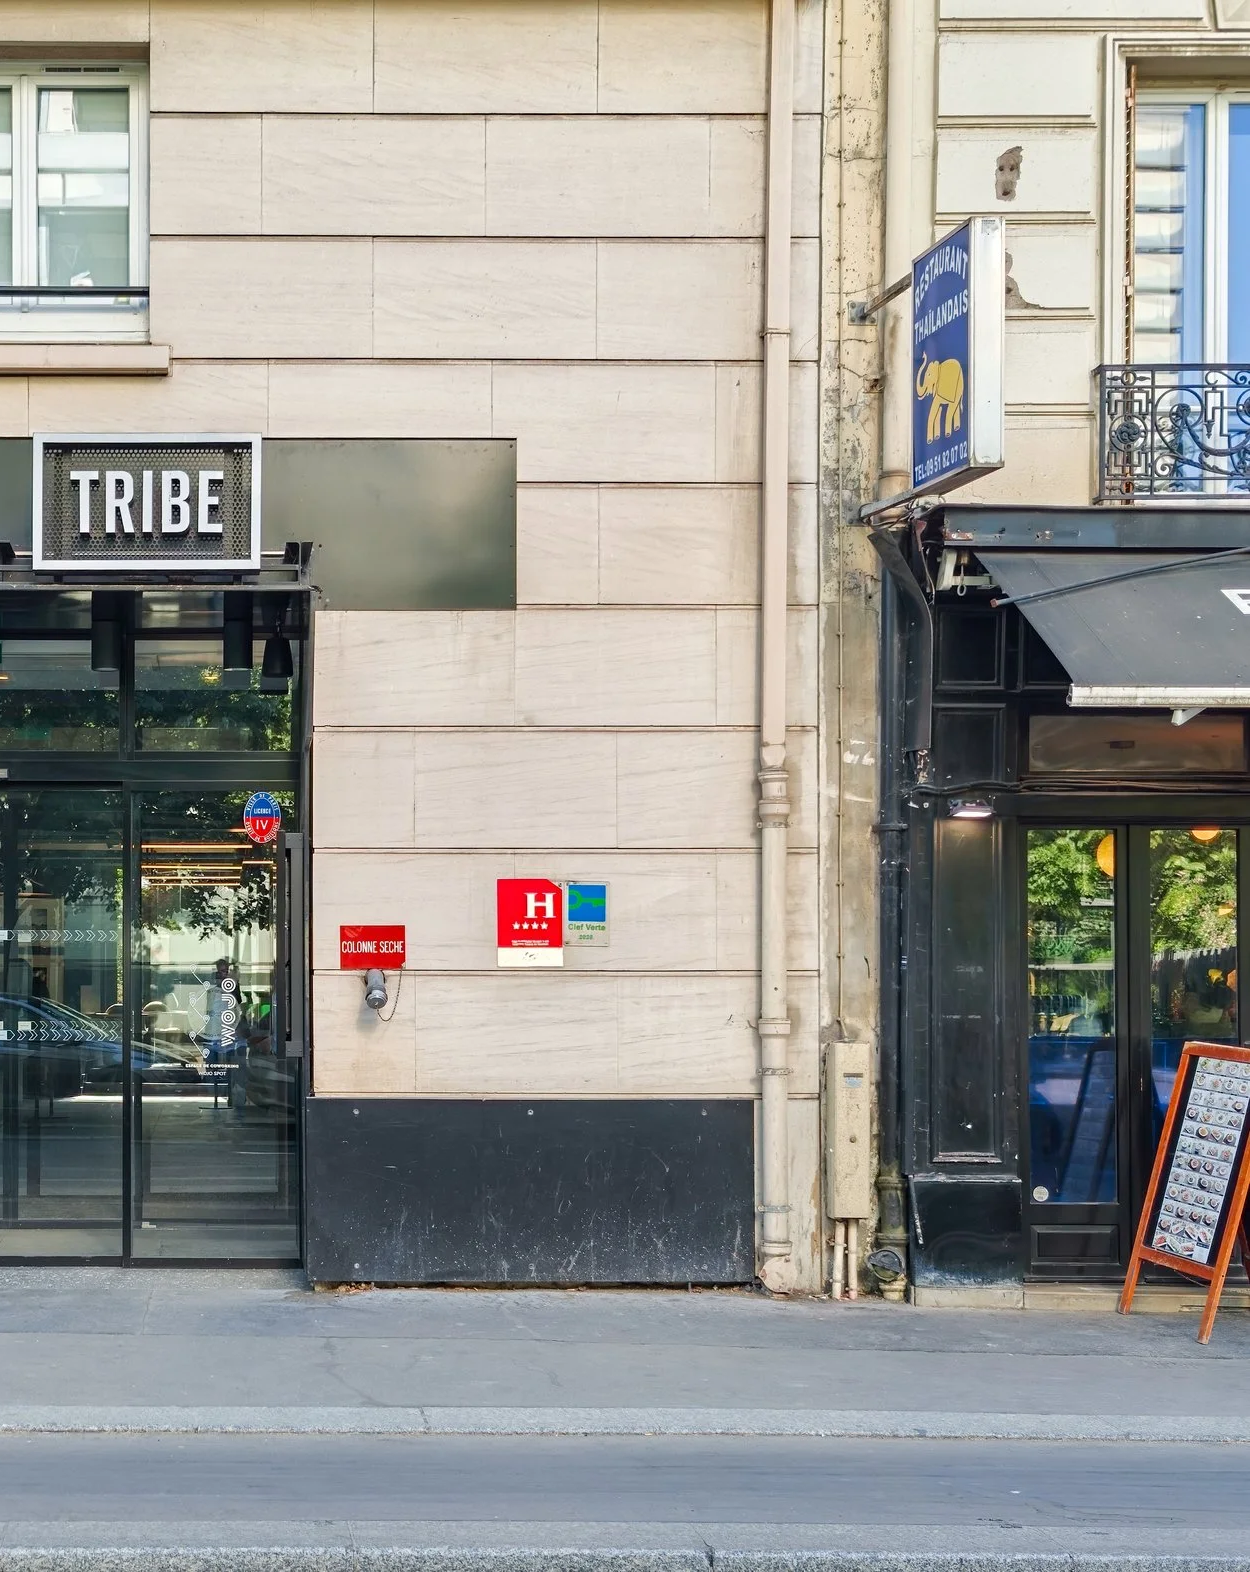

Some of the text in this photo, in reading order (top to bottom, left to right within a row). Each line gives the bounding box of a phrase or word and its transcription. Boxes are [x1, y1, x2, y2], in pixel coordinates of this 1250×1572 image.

[915, 245, 968, 314] RESTAURANT
[951, 445, 958, 464] 07
[960, 441, 967, 460] 02
[70, 470, 224, 533] TRIBE
[256, 820, 269, 830] IV
[523, 892, 556, 918] H
[341, 941, 405, 953] COLONNE SECHE
[221, 978, 236, 1047] WOJO
